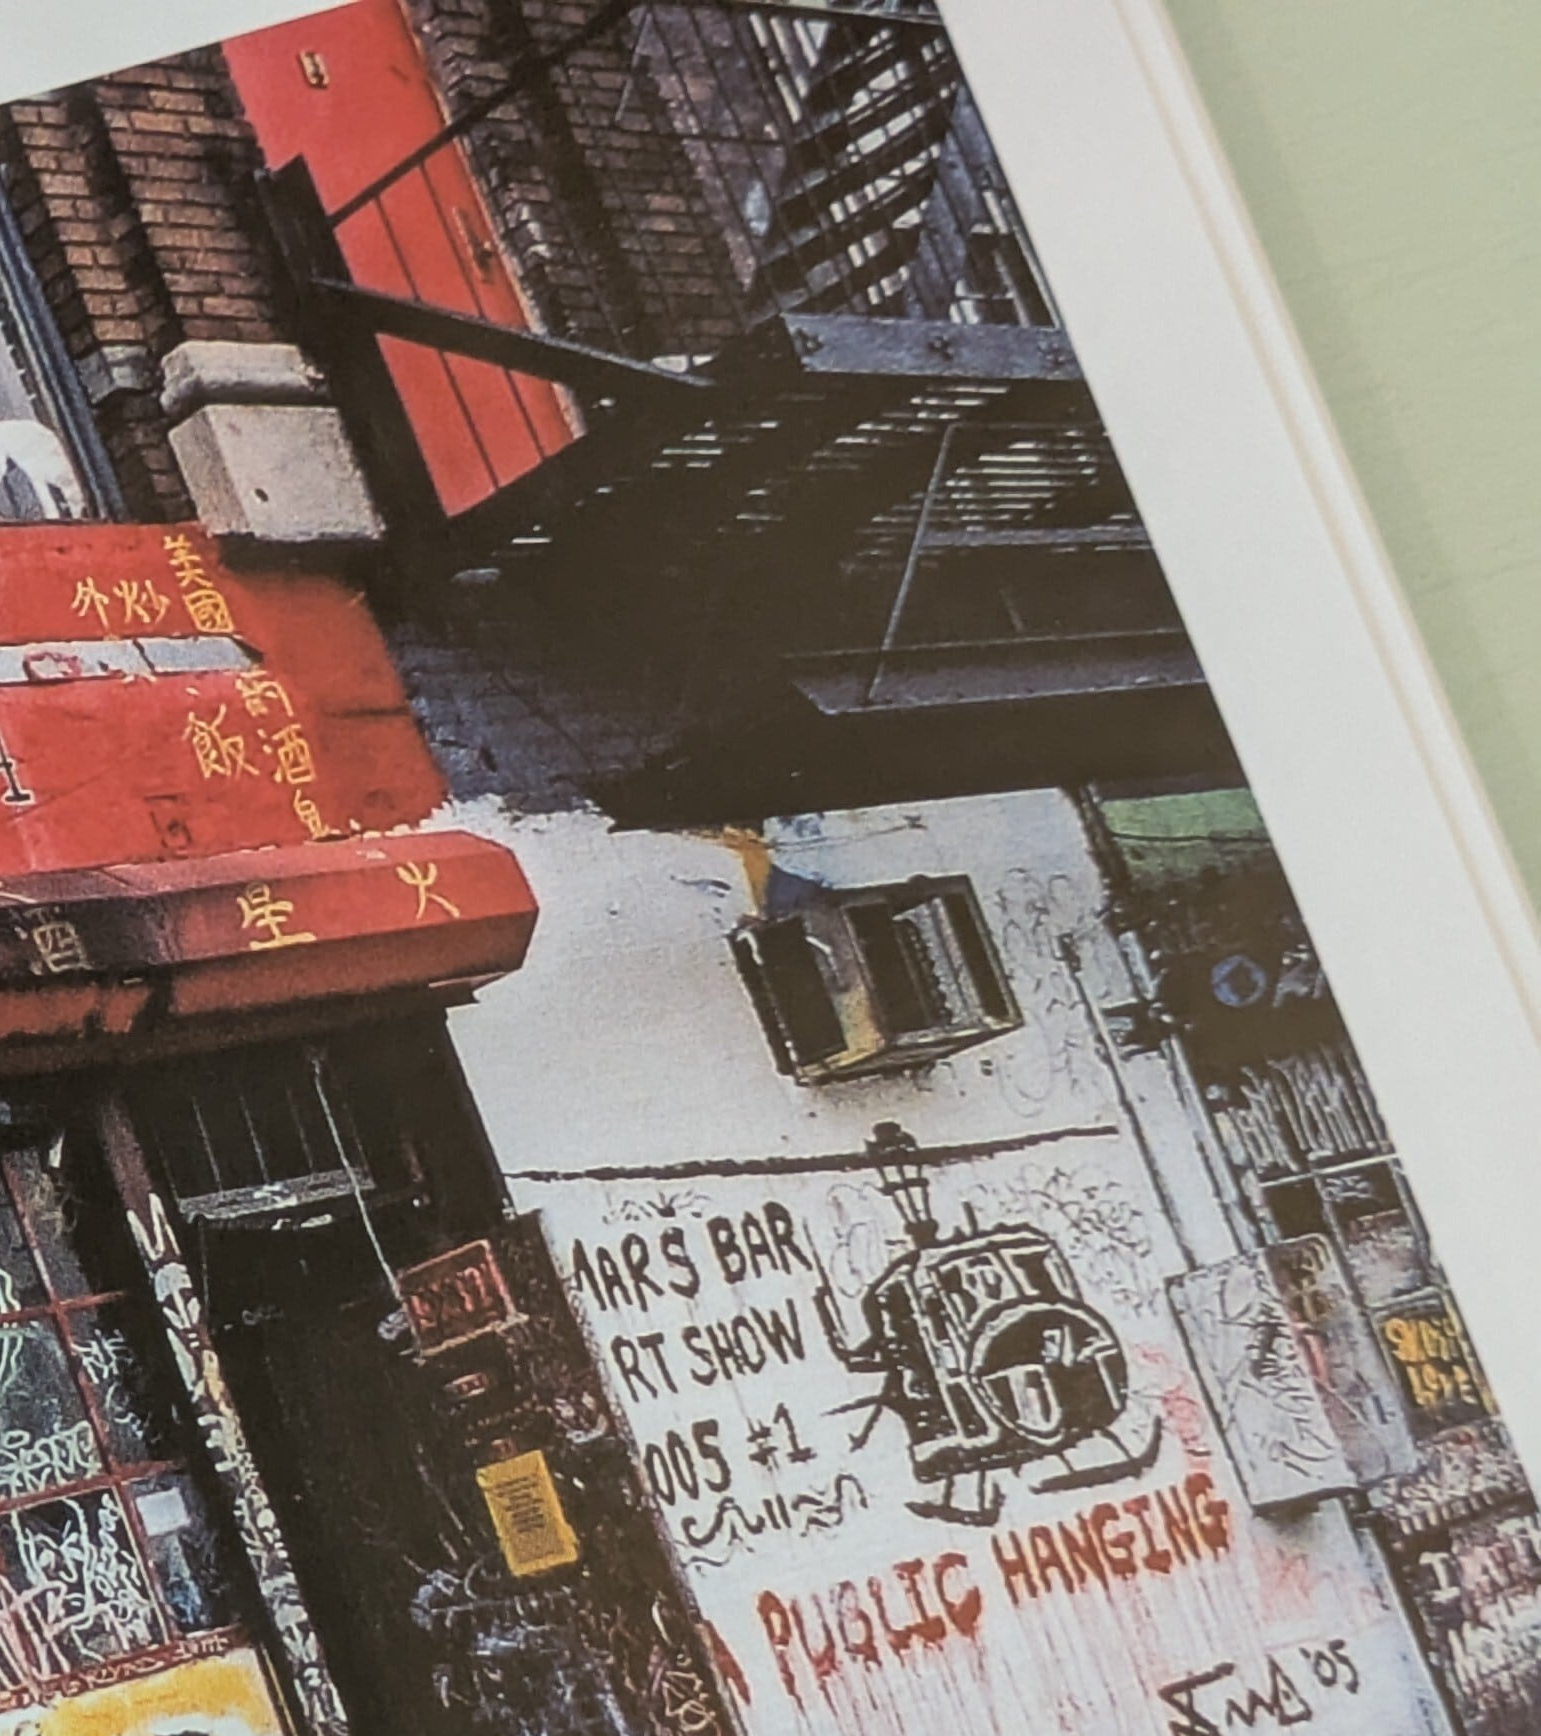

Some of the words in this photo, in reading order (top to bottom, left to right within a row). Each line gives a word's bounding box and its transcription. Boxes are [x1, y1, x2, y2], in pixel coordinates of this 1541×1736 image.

[707, 1202, 813, 1285] BAR
[682, 1299, 805, 1386] SHOW
[757, 1550, 983, 1690] PUBLIC
[991, 1472, 1230, 1605] HANGING
